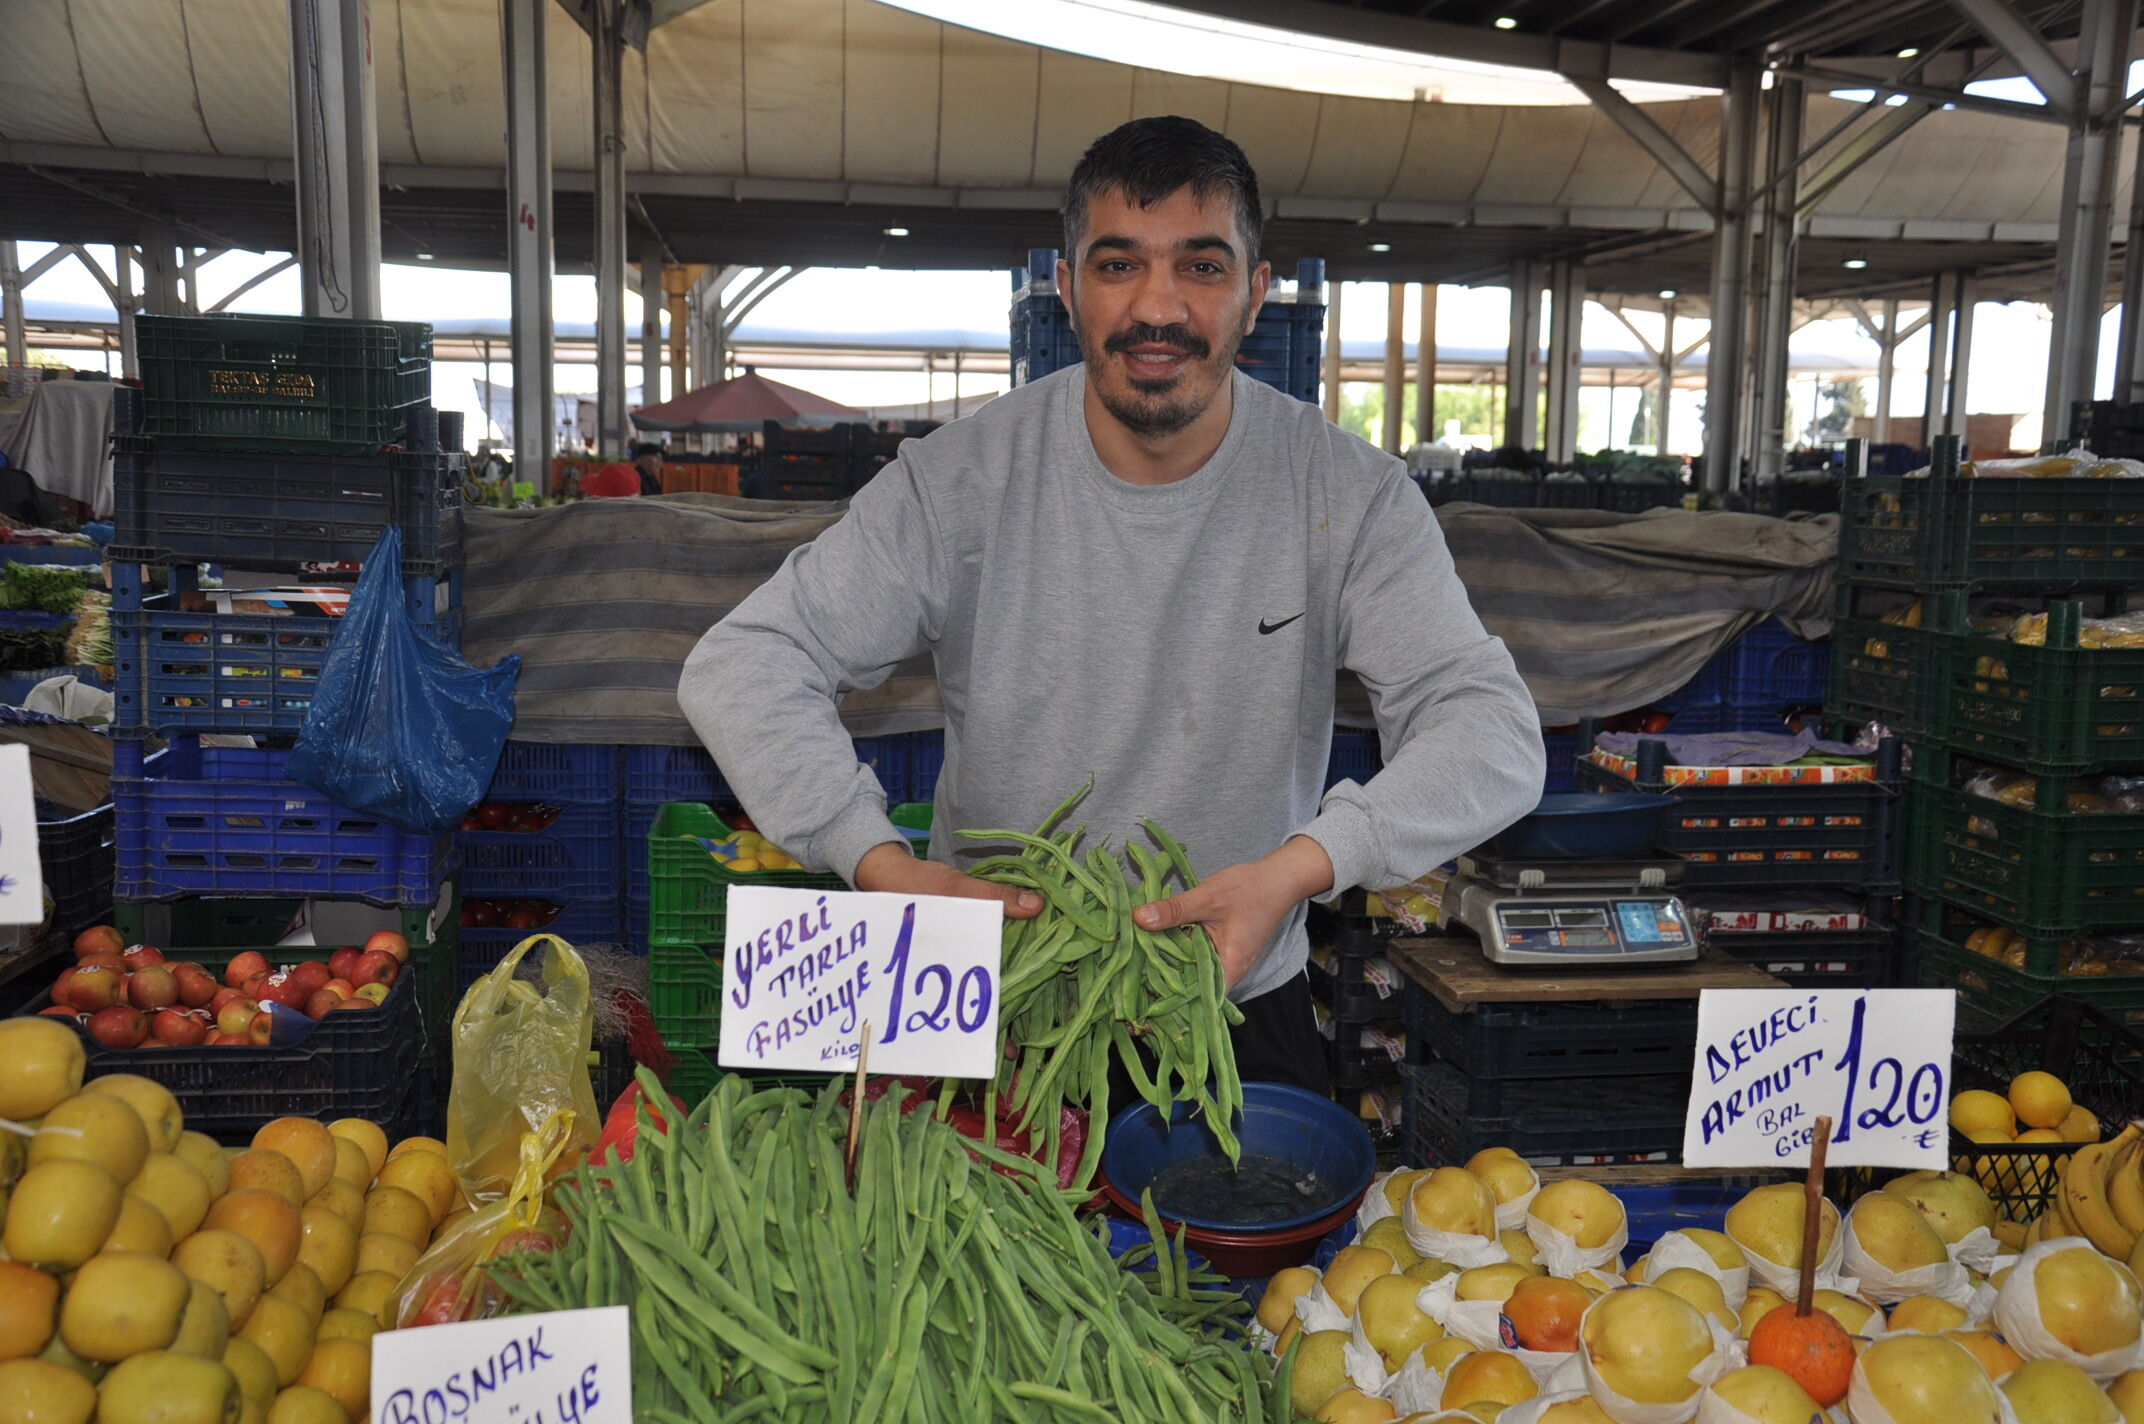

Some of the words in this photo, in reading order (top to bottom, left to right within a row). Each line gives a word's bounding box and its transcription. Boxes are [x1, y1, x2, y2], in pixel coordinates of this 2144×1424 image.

[768, 920, 867, 998] TARLA
[746, 960, 871, 1059] FASÜLYE
[1700, 1048, 1824, 1145] ARMUT
[1756, 1102, 1806, 1137] BAL
